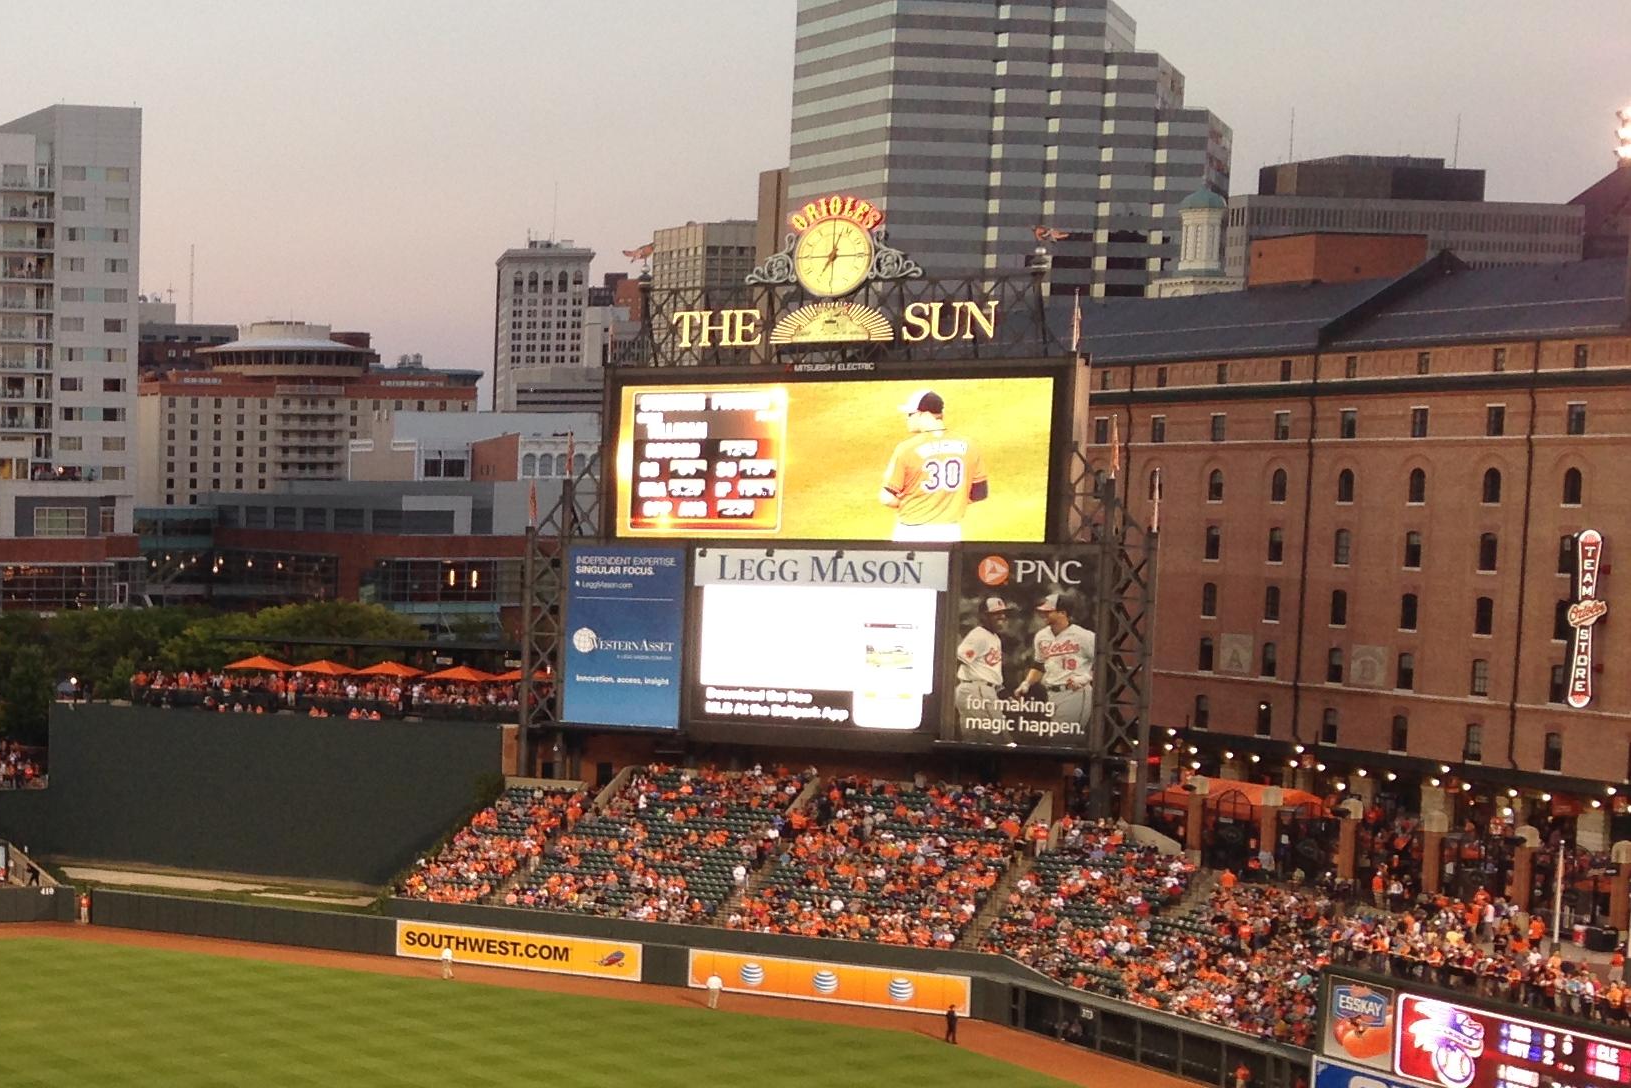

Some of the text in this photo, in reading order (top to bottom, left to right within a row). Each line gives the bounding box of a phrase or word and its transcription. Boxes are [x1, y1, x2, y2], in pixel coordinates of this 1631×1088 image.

[791, 195, 882, 232] ORIOLES
[672, 300, 999, 347] THE SUN
[794, 362, 875, 372] MITSUBISHI ELECTRIC
[924, 459, 962, 491] 30
[575, 565, 655, 576] SINGULAR FOCUS.
[576, 556, 632, 565] INDEPENDENT
[717, 554, 923, 585] LEGG MASON
[1014, 559, 1082, 585] PNC
[1581, 546, 1597, 597] TEAM
[1574, 629, 1589, 692] STORE
[965, 695, 1055, 717] for making
[965, 714, 1085, 737] magic happen.
[40, 888, 55, 896] 410
[405, 930, 570, 962] SOUTHWEST.COM
[1339, 993, 1383, 1018] ESSKAY
